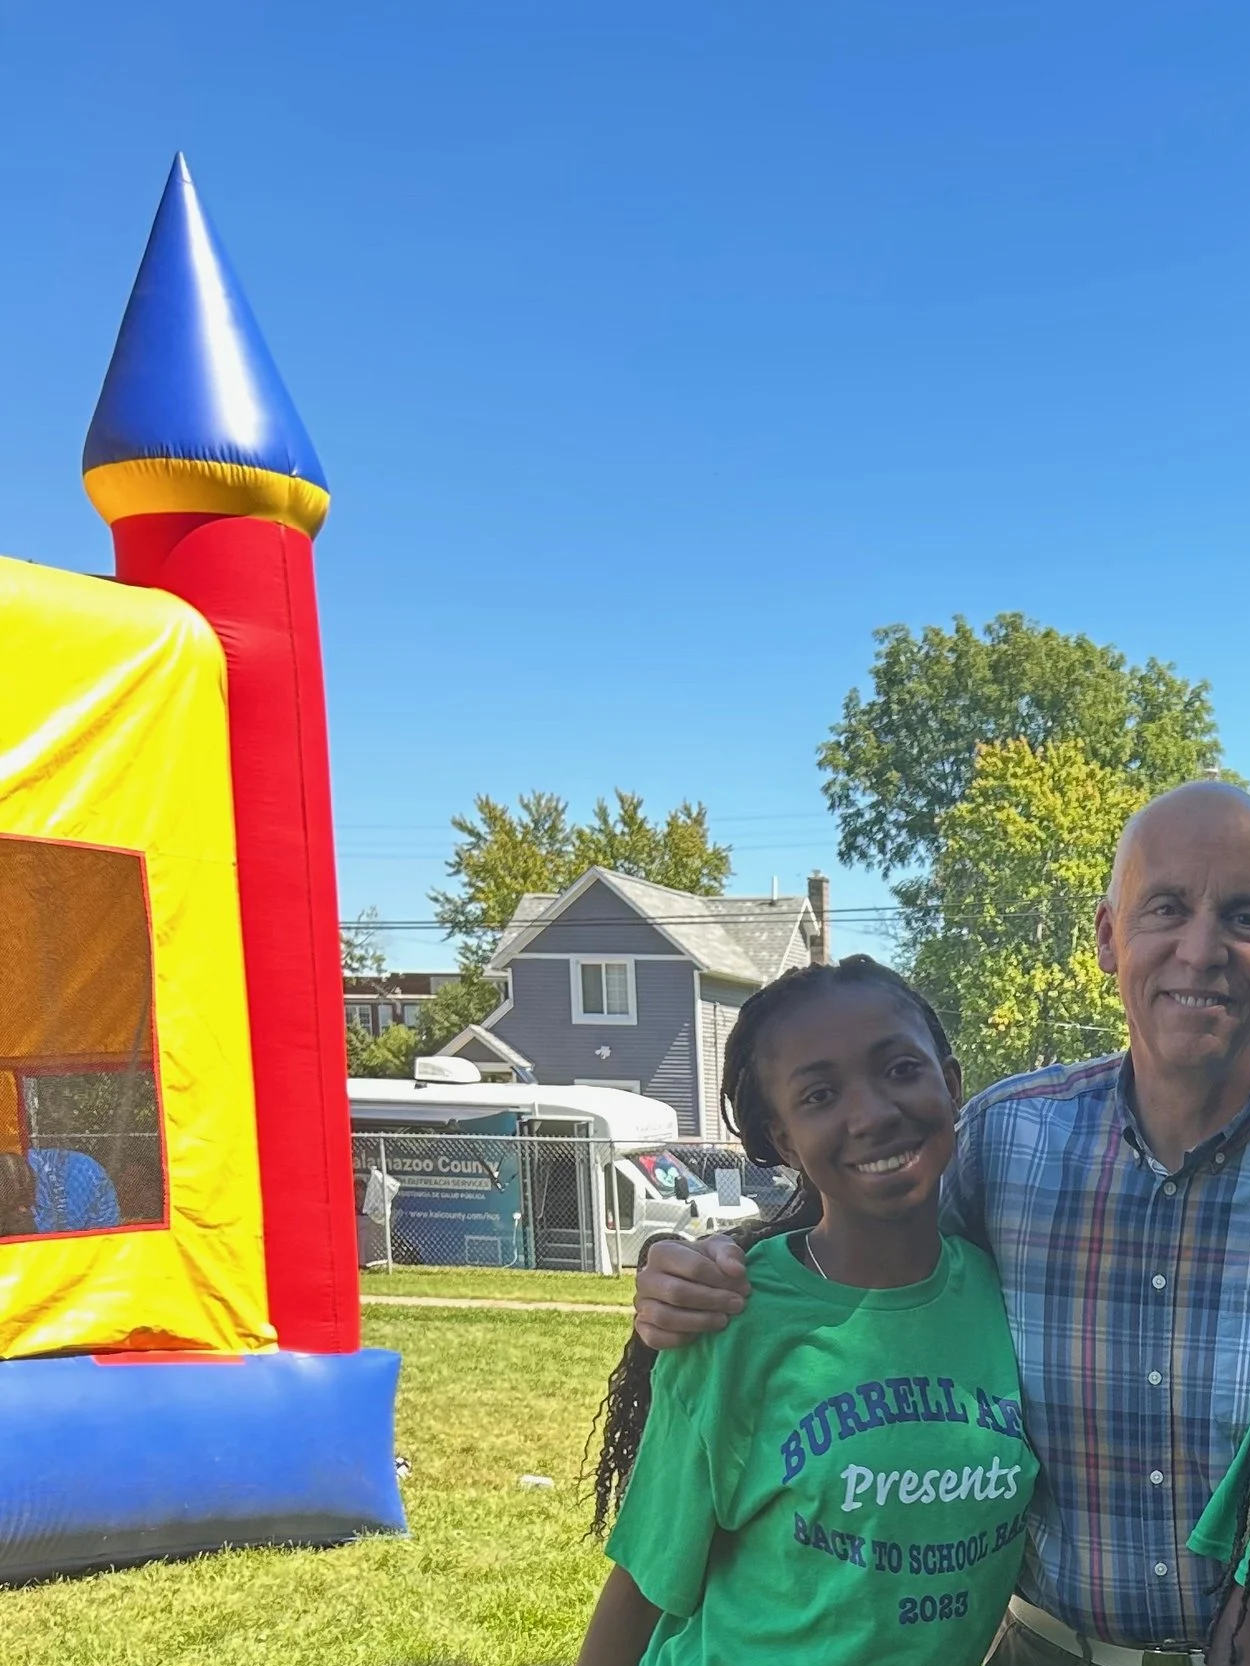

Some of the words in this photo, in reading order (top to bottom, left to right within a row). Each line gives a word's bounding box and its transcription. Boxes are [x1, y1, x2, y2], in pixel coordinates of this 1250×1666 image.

[352, 1149, 433, 1172] alamazoo
[780, 1376, 969, 1486] BURRELL
[975, 1386, 1026, 1441] AF
[840, 1455, 1021, 1512] Presents
[794, 1511, 866, 1568] BACK
[871, 1539, 903, 1573] TO
[908, 1530, 989, 1575] SCHOOL
[898, 1590, 969, 1625] 2023
